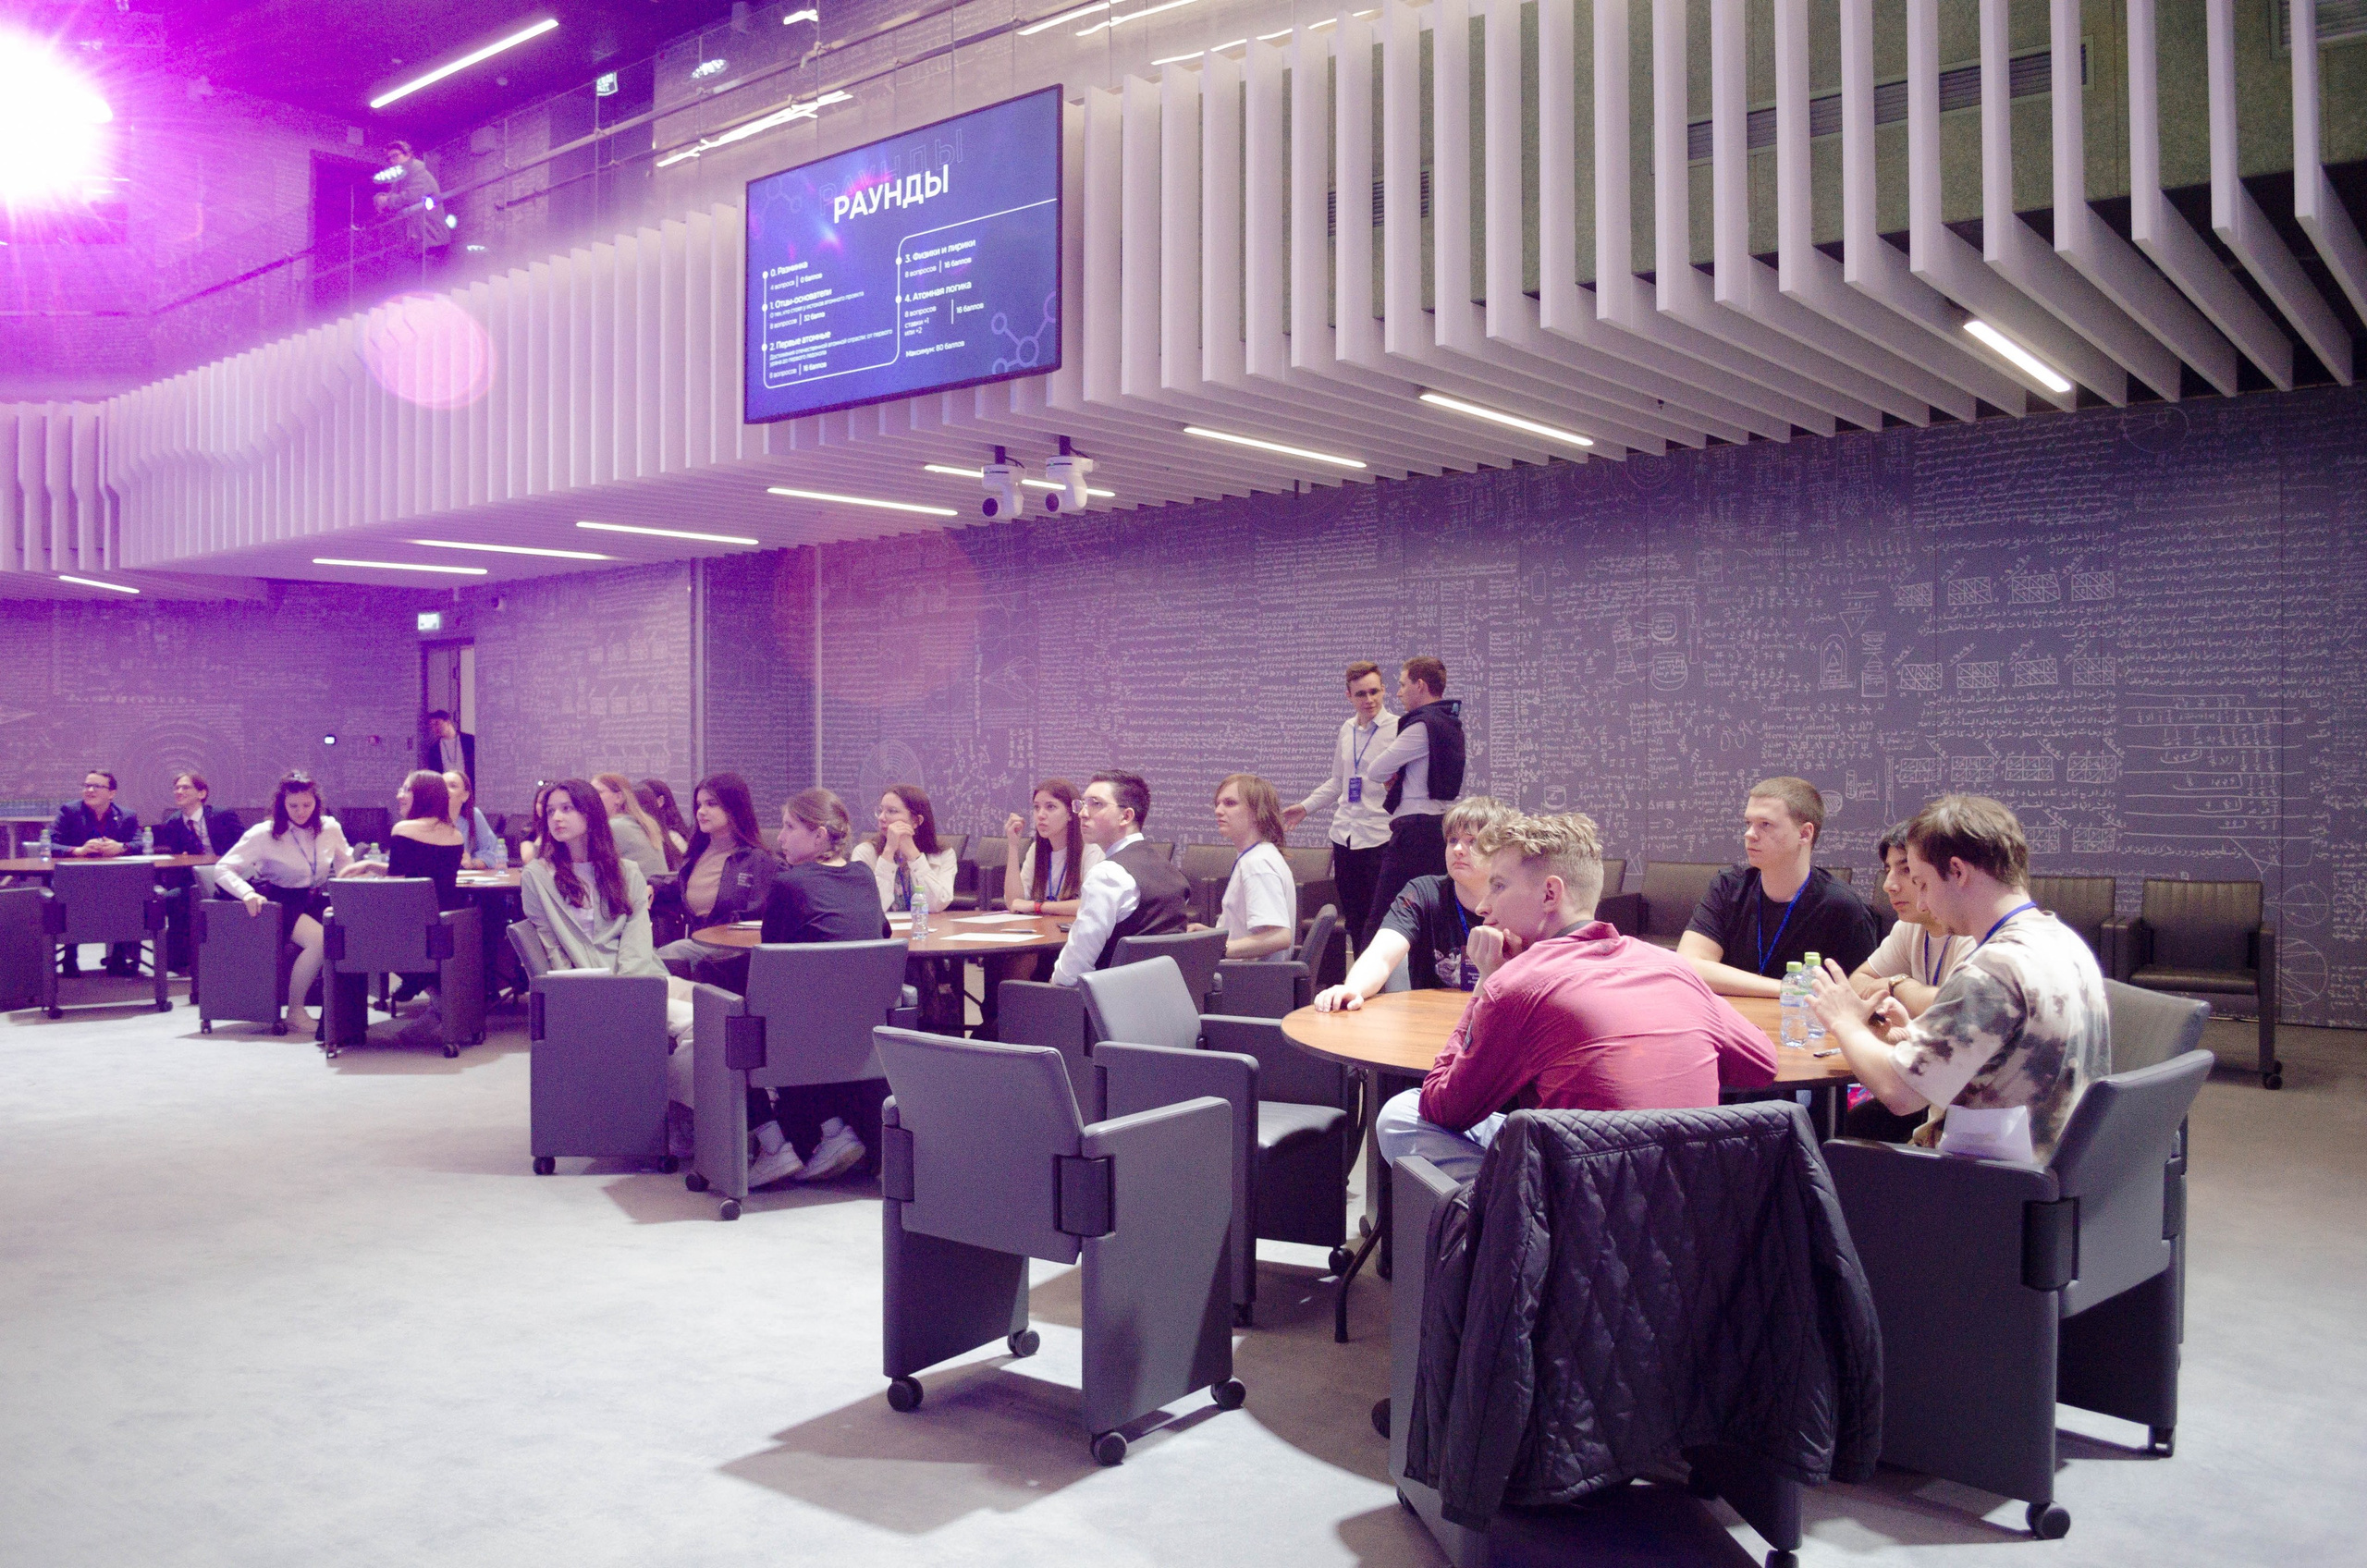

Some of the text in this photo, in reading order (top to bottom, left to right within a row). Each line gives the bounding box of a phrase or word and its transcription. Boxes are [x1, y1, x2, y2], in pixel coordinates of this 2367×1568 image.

[834, 164, 949, 224] РАУНДЫ
[913, 248, 940, 261] Физики
[941, 246, 947, 254] и
[948, 239, 976, 252] лирики
[950, 257, 972, 267] баллов
[910, 265, 937, 277] вопросов
[804, 273, 823, 282] баллов
[904, 281, 972, 302] 4. Атомная логика
[909, 306, 937, 317] вопросов
[963, 302, 984, 312] баллов
[904, 320, 924, 328] ставки
[776, 337, 802, 349] Первые
[802, 331, 831, 345] атомные
[905, 340, 965, 358] Максимум: 80 баллов
